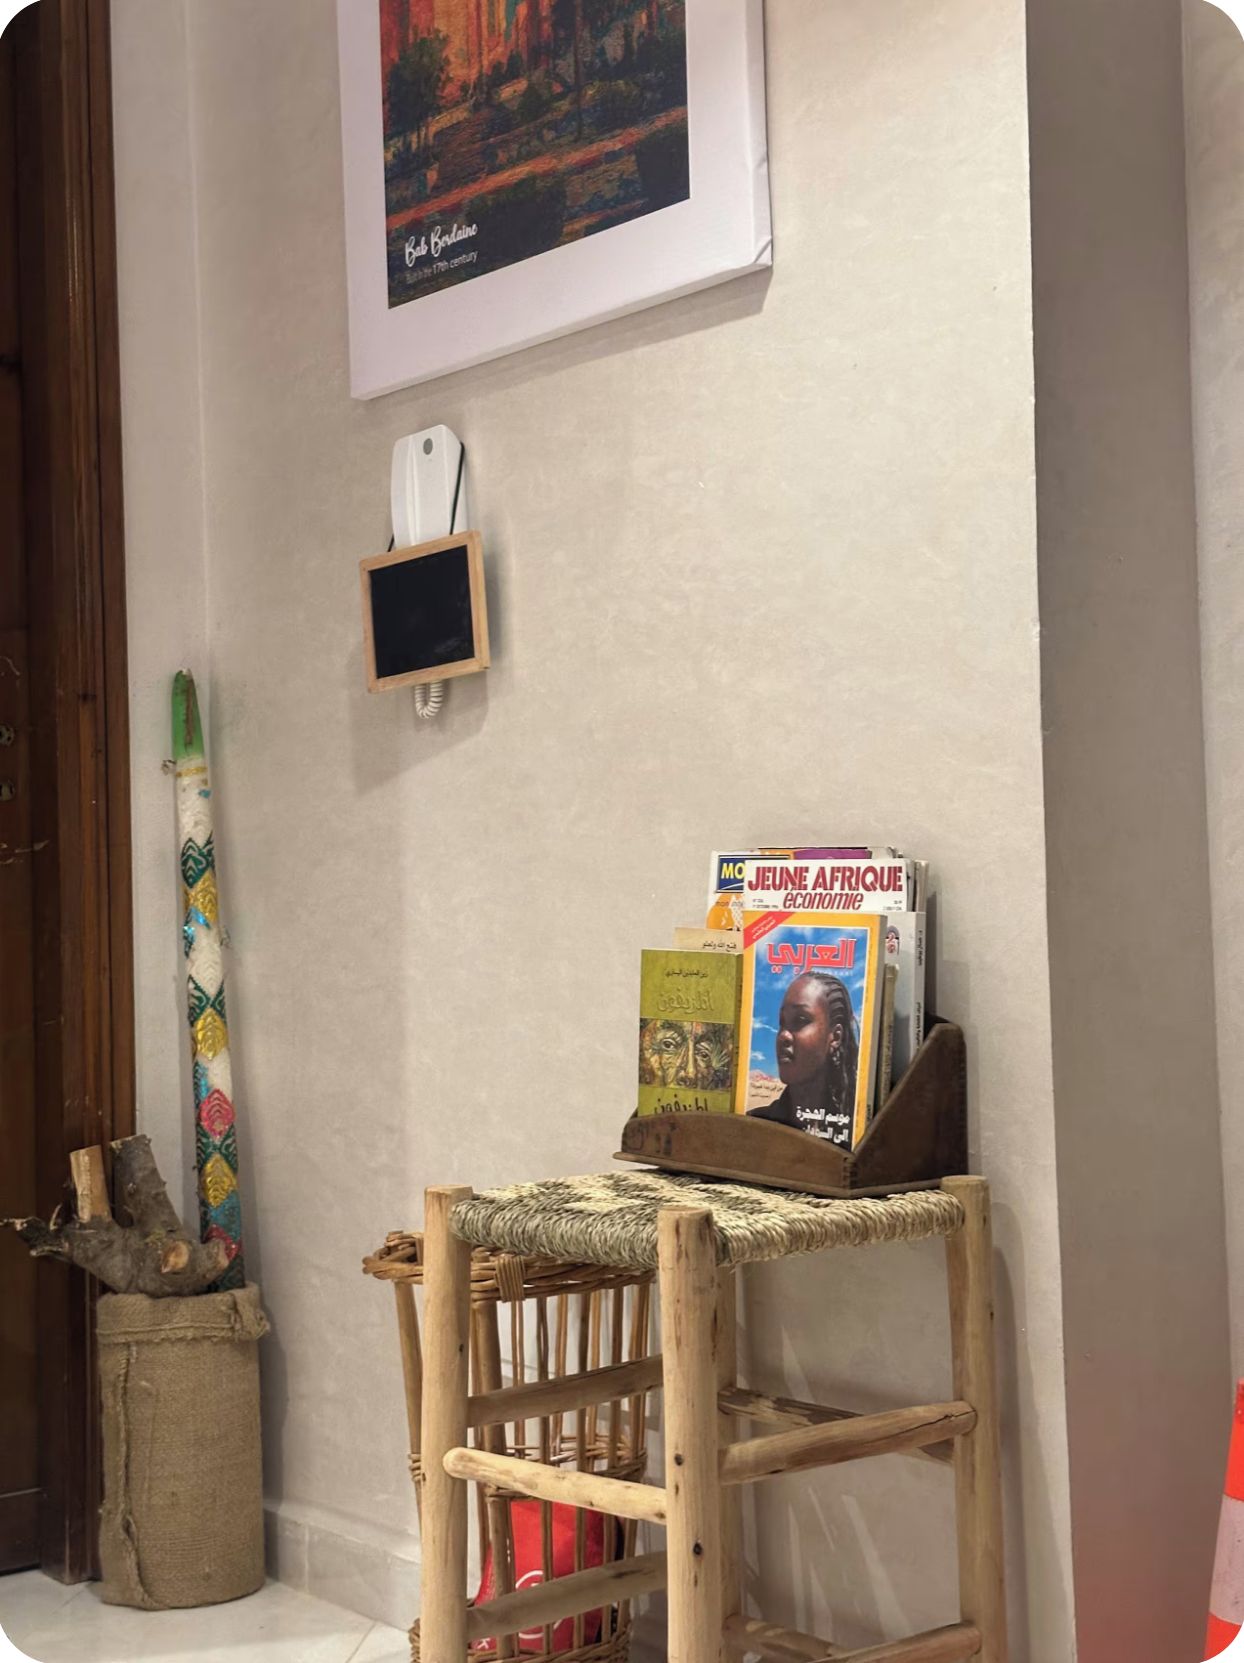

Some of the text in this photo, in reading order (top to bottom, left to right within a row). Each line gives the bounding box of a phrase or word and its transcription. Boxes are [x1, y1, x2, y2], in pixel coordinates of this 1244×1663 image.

[405, 236, 428, 267] Bab
[433, 260, 449, 274] 17th
[450, 251, 478, 269] century
[747, 866, 903, 892] JEUNE AFRIQUE
[783, 888, 864, 910] économie
[766, 938, 856, 974] العربي
[796, 1106, 825, 1121] الهجرة
[825, 1113, 850, 1126] موسم
